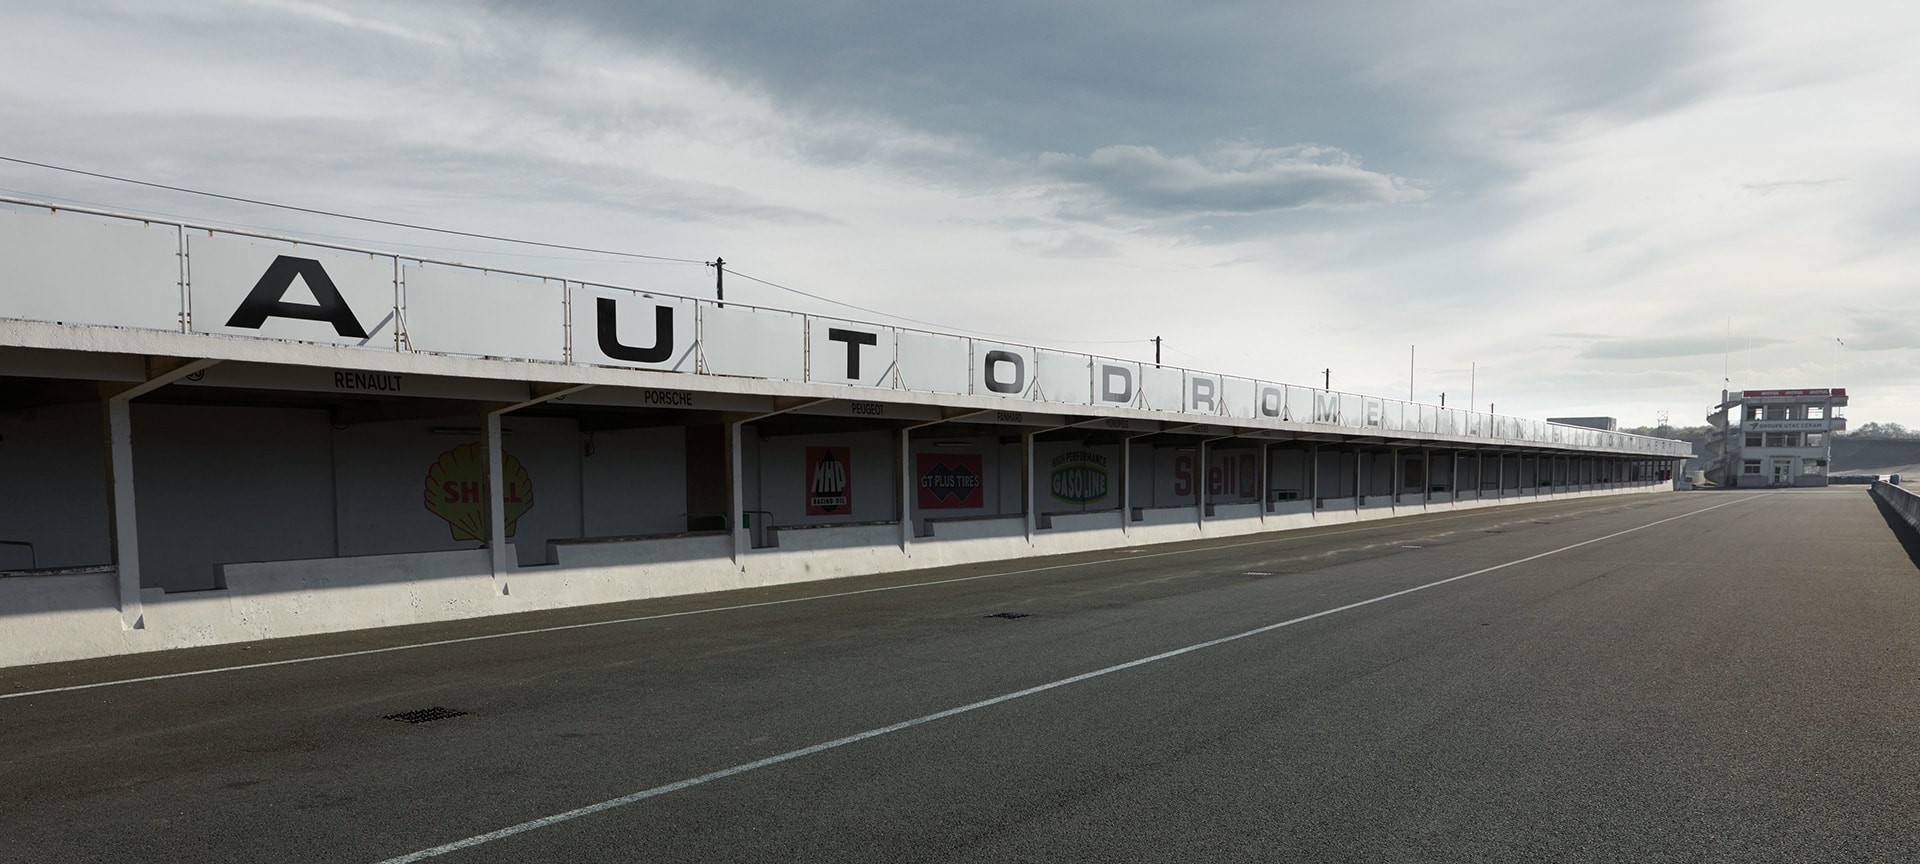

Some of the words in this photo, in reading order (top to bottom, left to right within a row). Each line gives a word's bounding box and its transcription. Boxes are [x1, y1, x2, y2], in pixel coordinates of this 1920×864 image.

[226, 255, 1380, 427] AUTODROME
[334, 372, 402, 391] RENAULT
[644, 391, 692, 406] PORSCHE
[851, 403, 884, 416] PEUGEOT
[997, 411, 1022, 423] PANHARD
[1052, 455, 1066, 468] HIGH
[1066, 450, 1107, 467] PERFORMANCE
[811, 460, 847, 493] MHP
[921, 475, 935, 488] GT
[935, 475, 955, 488] PLUS
[956, 475, 980, 487] TIRES
[1052, 469, 1107, 499] GASOLINE
[813, 497, 834, 505] RACING
